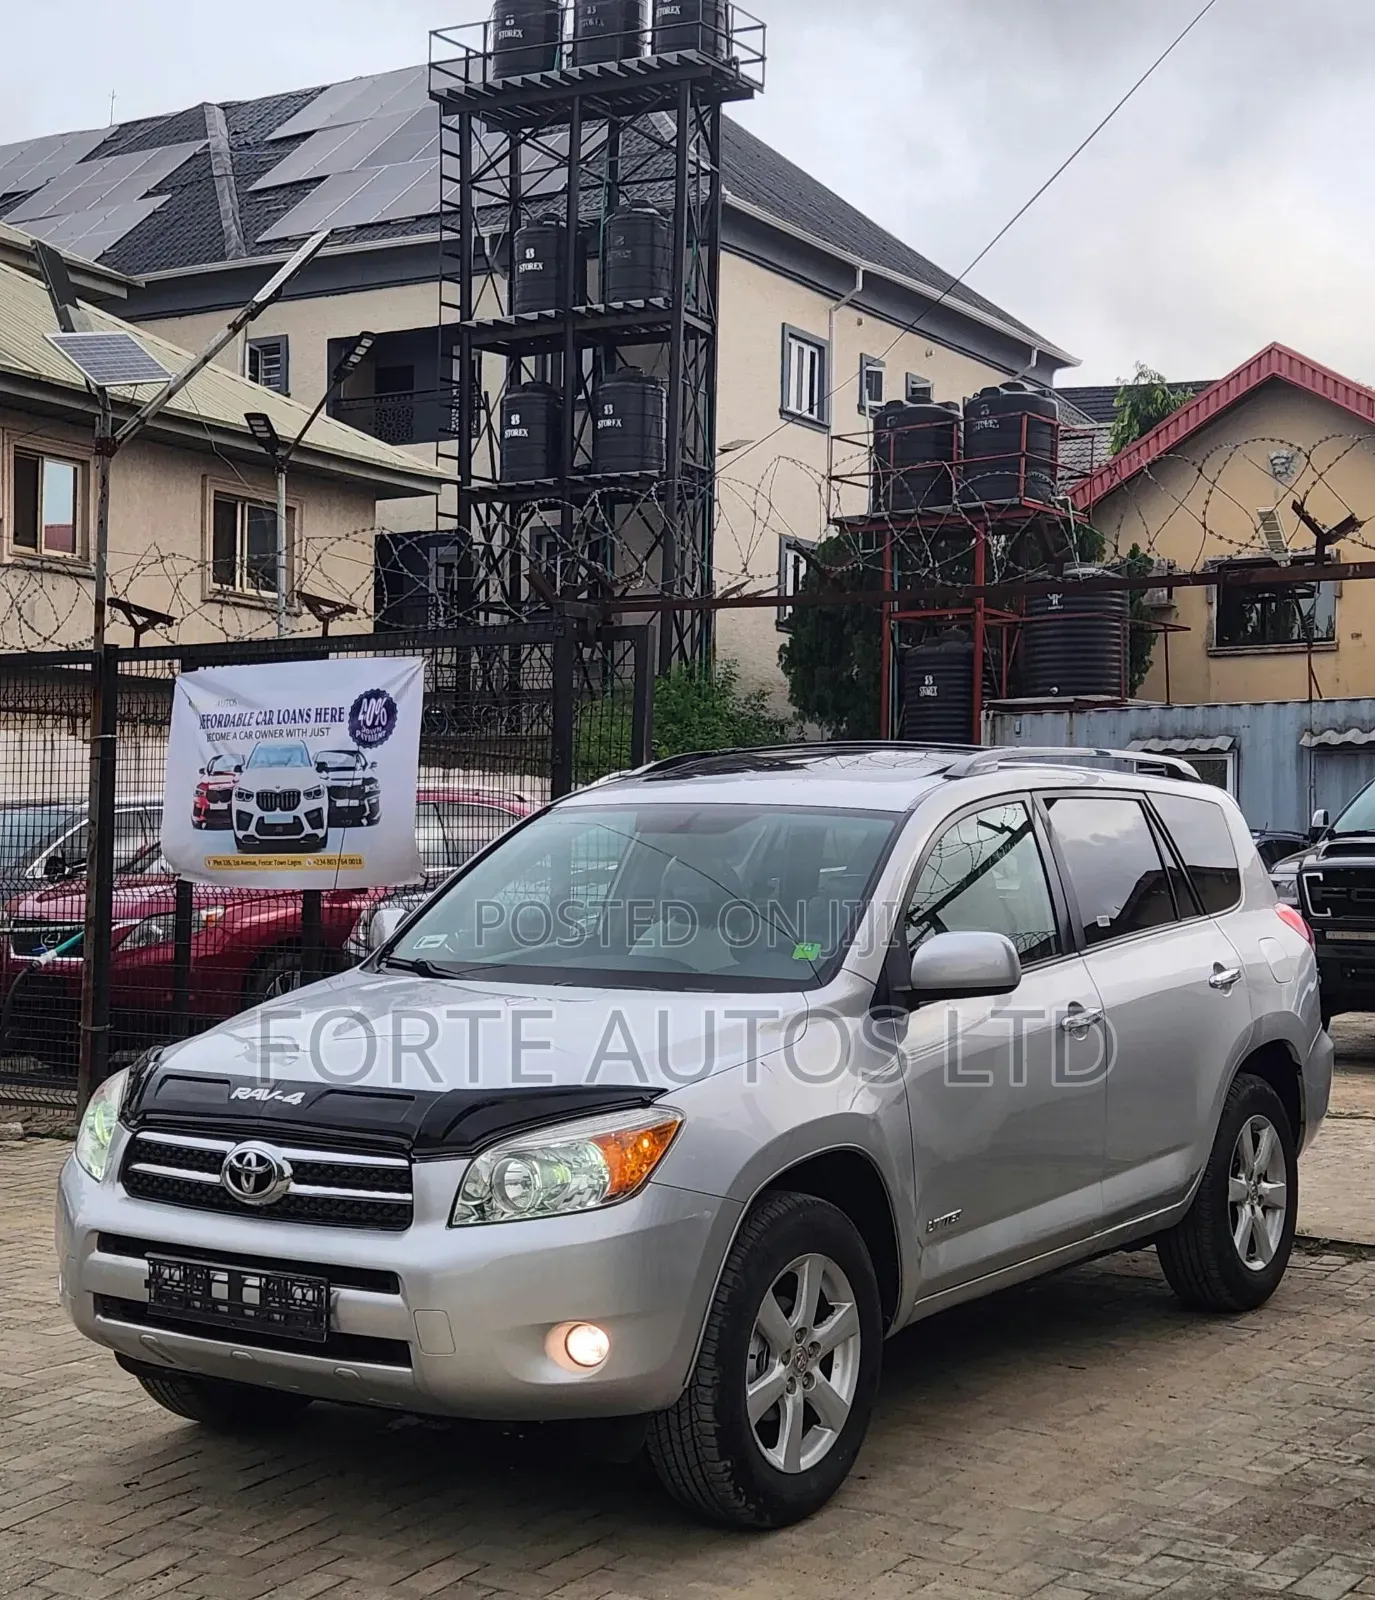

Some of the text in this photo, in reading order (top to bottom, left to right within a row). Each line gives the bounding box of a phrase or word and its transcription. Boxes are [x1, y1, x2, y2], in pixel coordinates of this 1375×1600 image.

[656, 5, 681, 17] STOREX
[498, 29, 523, 39] STOREX
[518, 262, 544, 273] STOREX
[597, 419, 622, 430] STOREX
[504, 428, 529, 438] STOREX
[919, 686, 938, 697] STOREX
[357, 697, 388, 727] 40%
[199, 706, 345, 730] AFFORDABLE CAR LOANS HERE
[232, 730, 238, 741] A
[239, 730, 254, 741] CAR
[254, 728, 284, 740] OWNER
[285, 727, 308, 739] WITH
[308, 727, 331, 738] JUST
[230, 1086, 306, 1106] RAV-4
